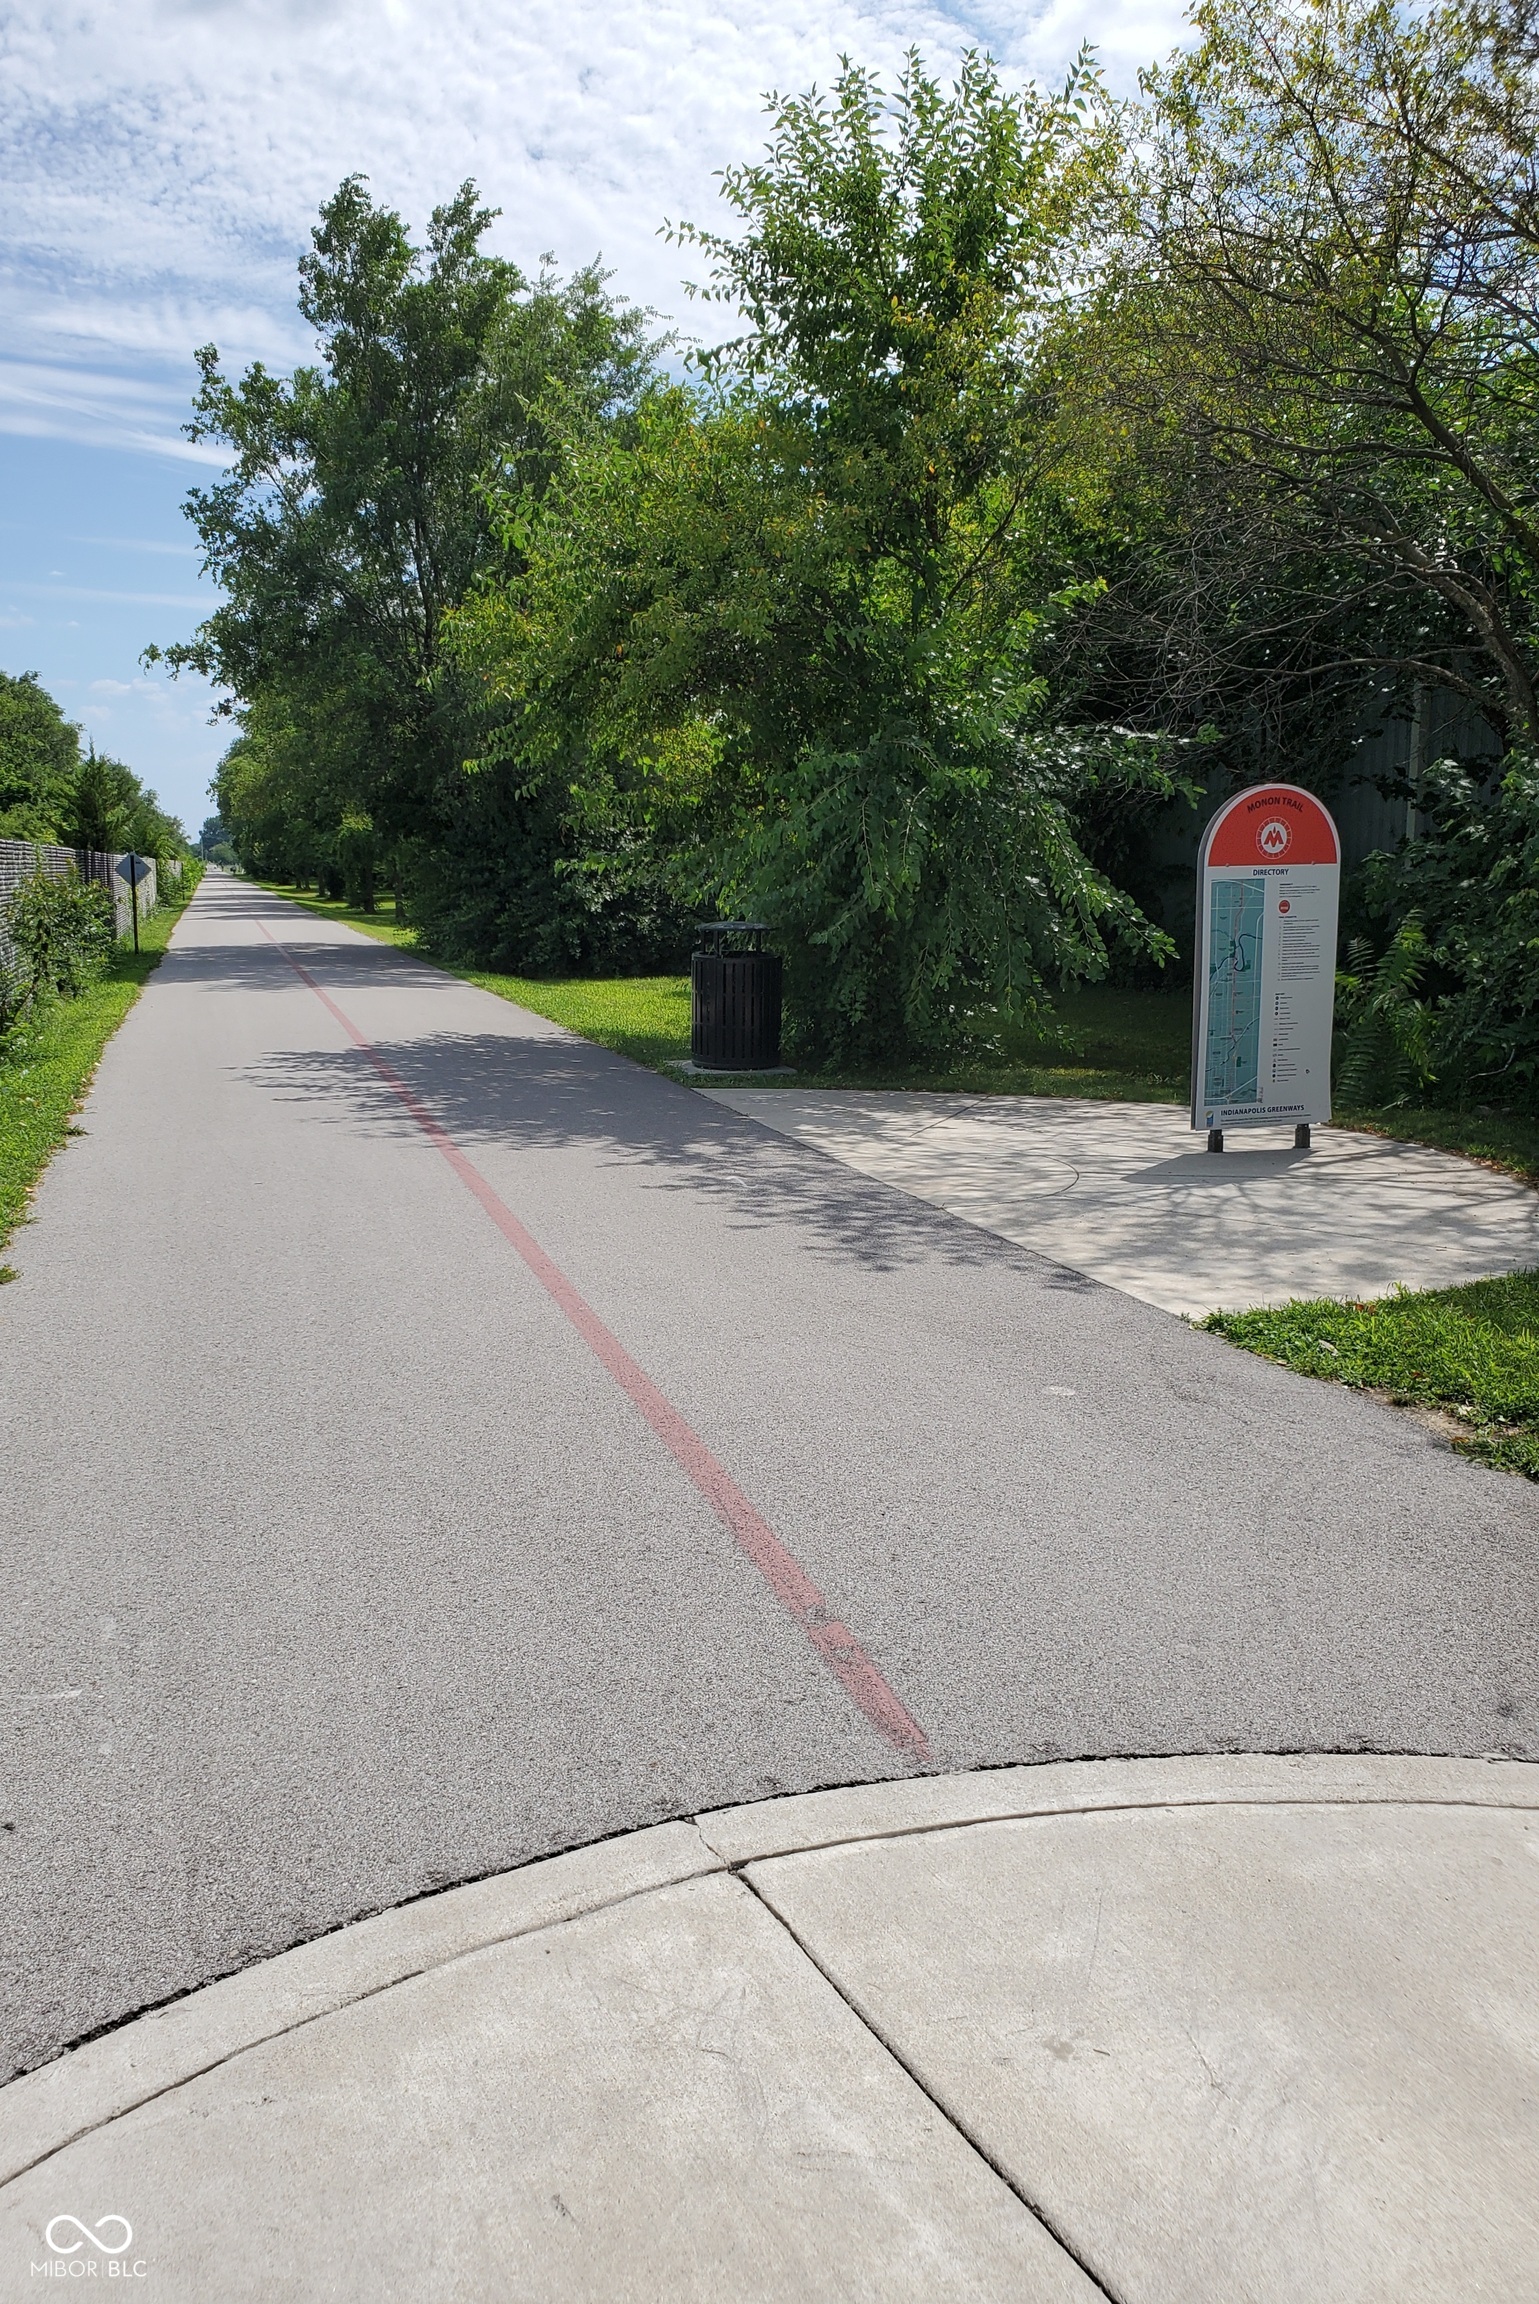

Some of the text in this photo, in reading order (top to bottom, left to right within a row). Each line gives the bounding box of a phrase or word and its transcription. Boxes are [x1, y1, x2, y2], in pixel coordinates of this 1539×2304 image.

[1247, 796, 1304, 813] MONON TRAIL
[1252, 868, 1289, 876] DIRECTORY
[1220, 1104, 1305, 1116] INDIANAPOLIS GREENWAYS
